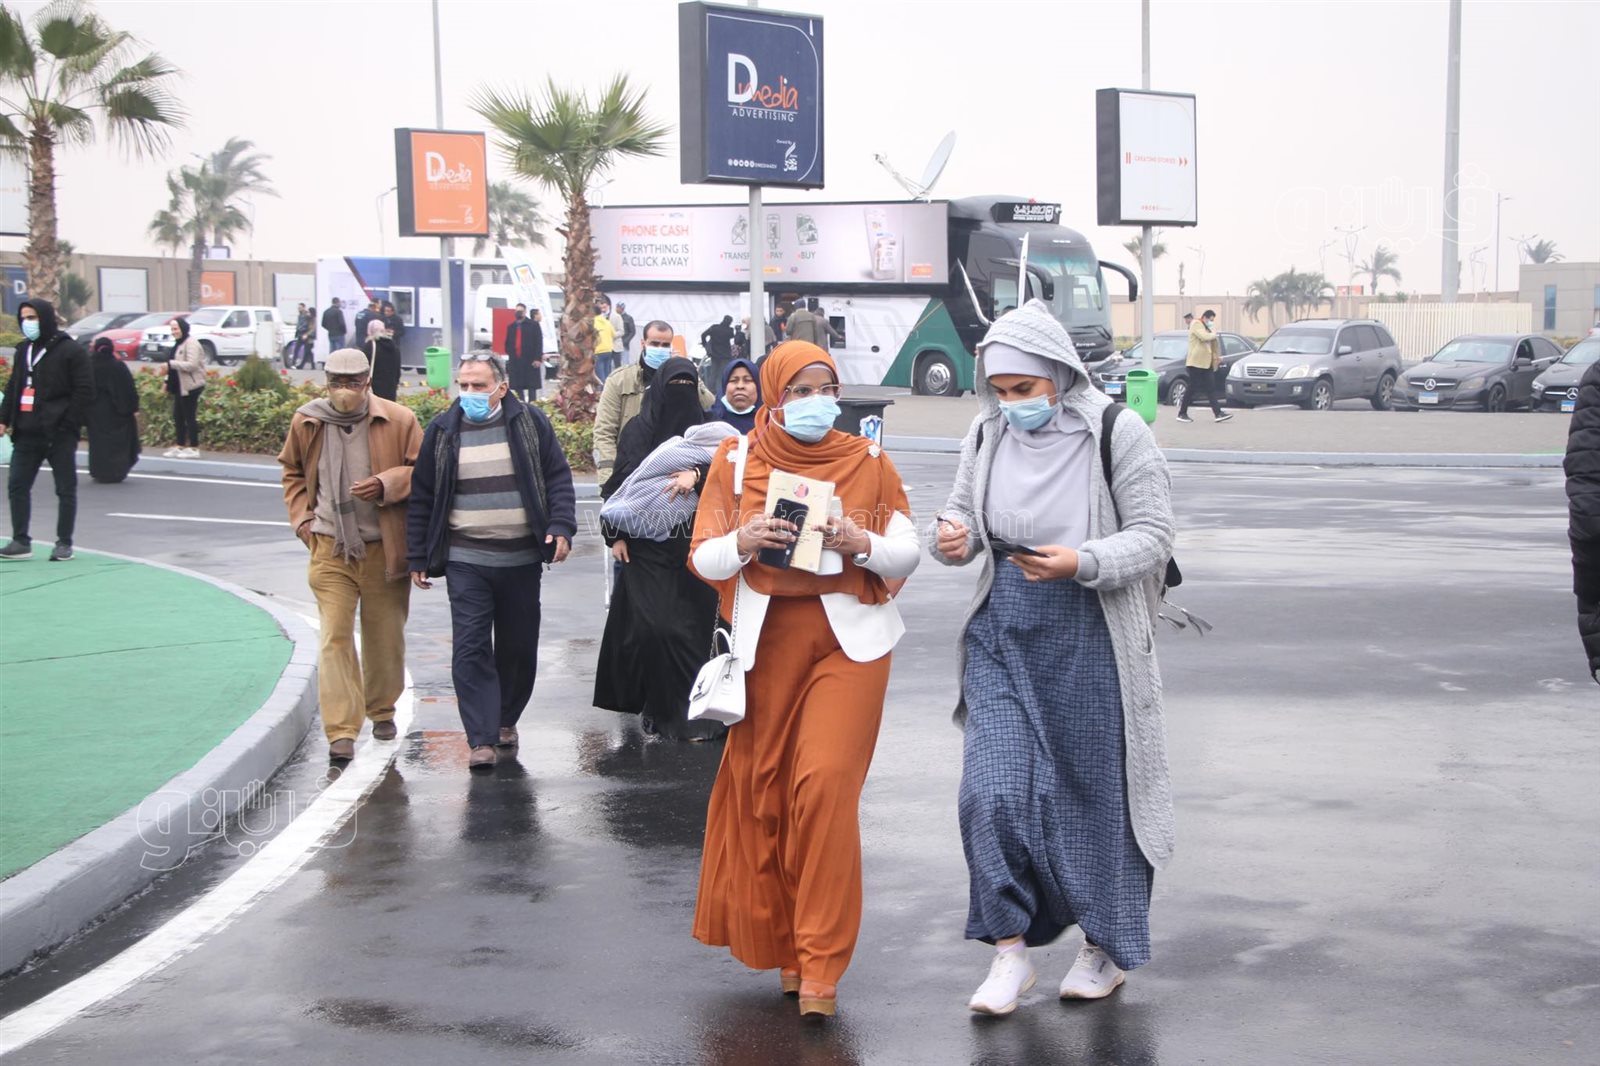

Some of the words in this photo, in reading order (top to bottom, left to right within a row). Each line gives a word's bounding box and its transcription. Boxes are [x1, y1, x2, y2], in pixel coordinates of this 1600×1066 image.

[732, 108, 794, 122] ADVERTISING
[621, 225, 658, 236] PHONE
[660, 225, 689, 236] CASH
[621, 243, 679, 254] EVERYTHING
[681, 243, 690, 254] IS
[770, 251, 783, 259] PAY
[800, 251, 816, 260] BUY
[622, 256, 629, 267] A
[630, 256, 658, 267] CLICK
[660, 256, 689, 267] AWAY
